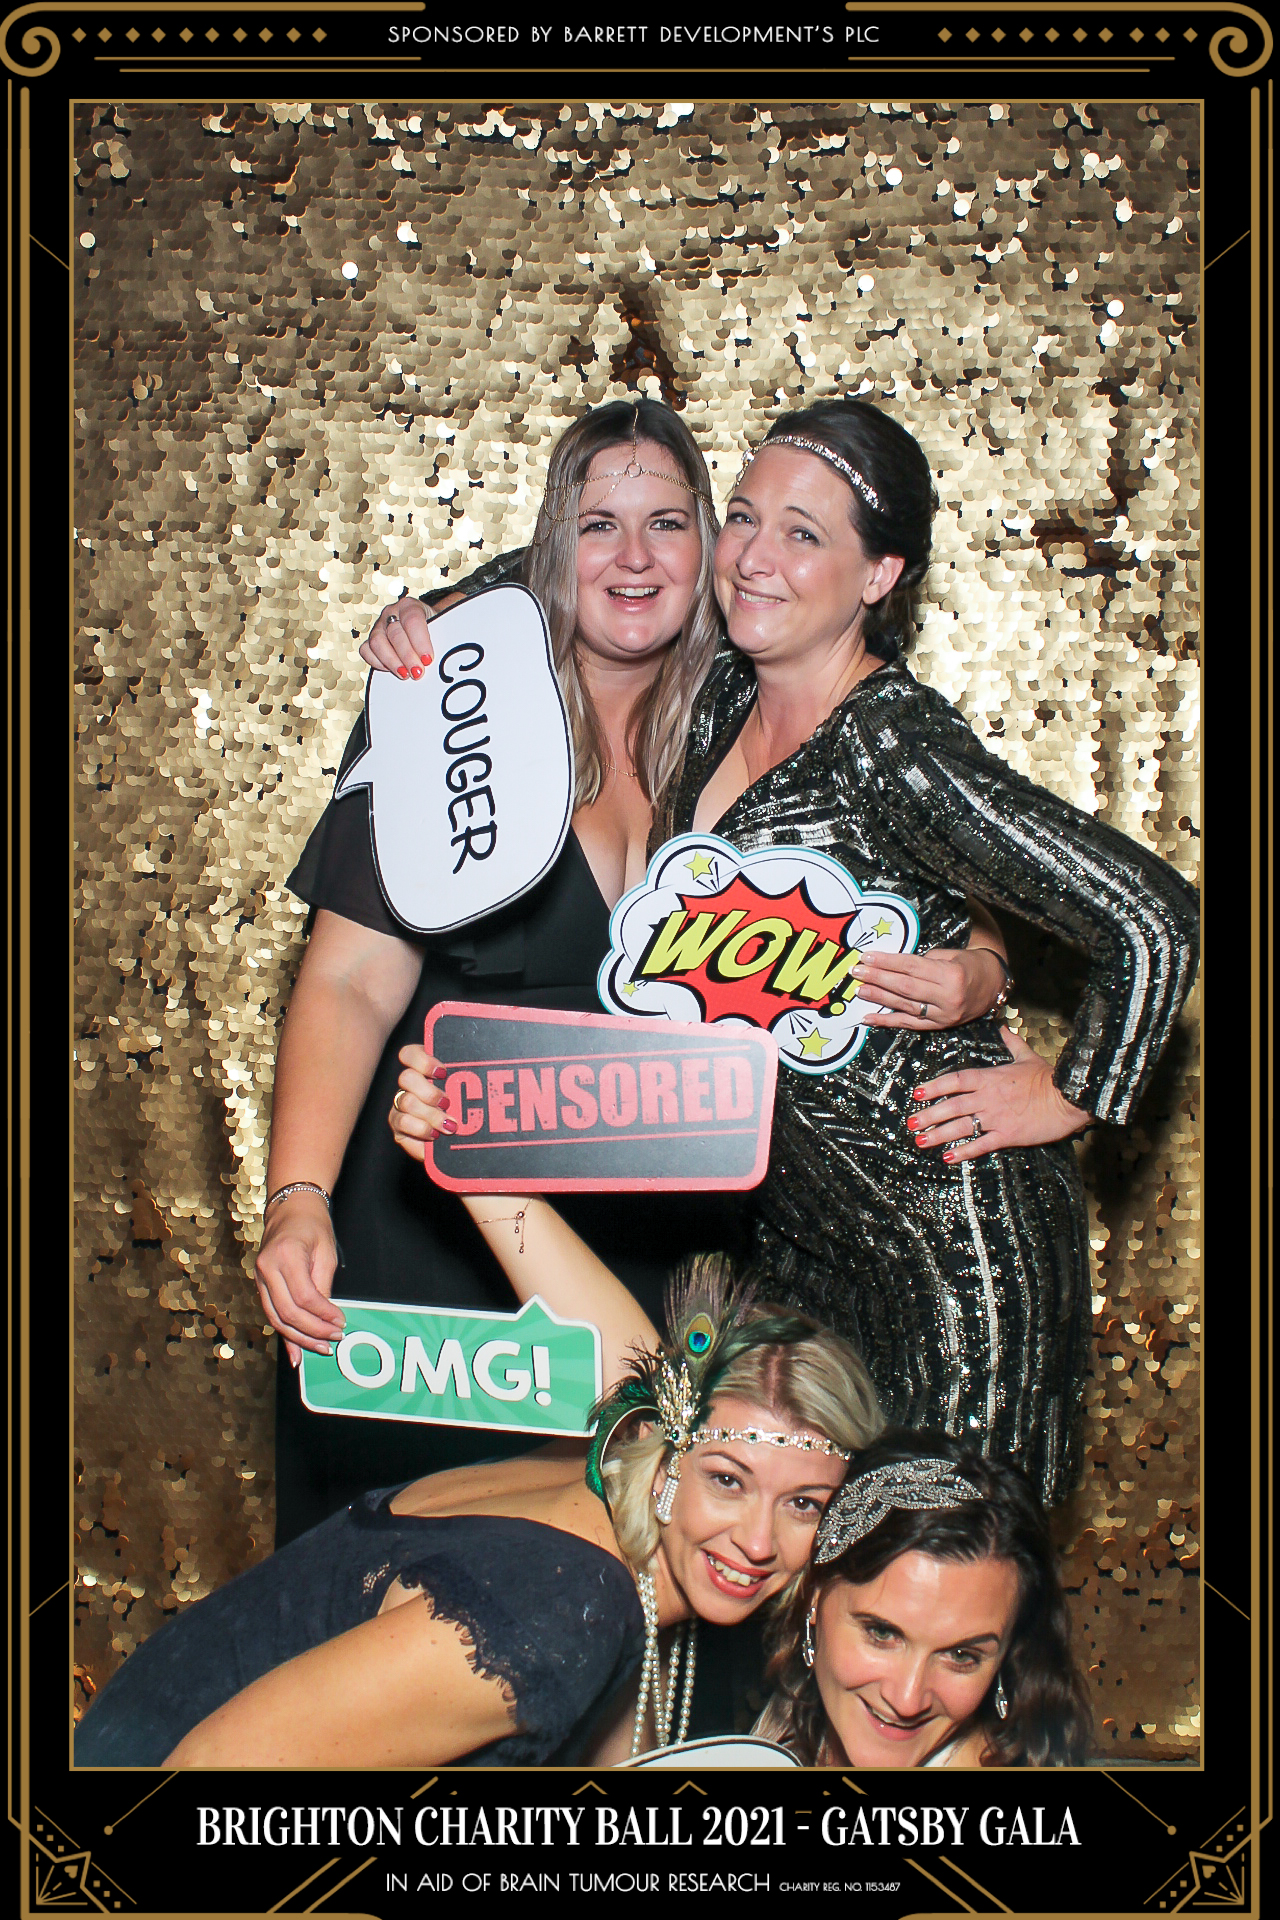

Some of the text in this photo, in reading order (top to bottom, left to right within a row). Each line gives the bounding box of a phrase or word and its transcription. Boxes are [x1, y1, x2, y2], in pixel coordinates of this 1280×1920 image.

[438, 642, 498, 875] COUGER
[640, 909, 866, 1017] WOW!
[444, 1055, 755, 1137] CENSORED
[336, 1330, 552, 1407] OMG!
